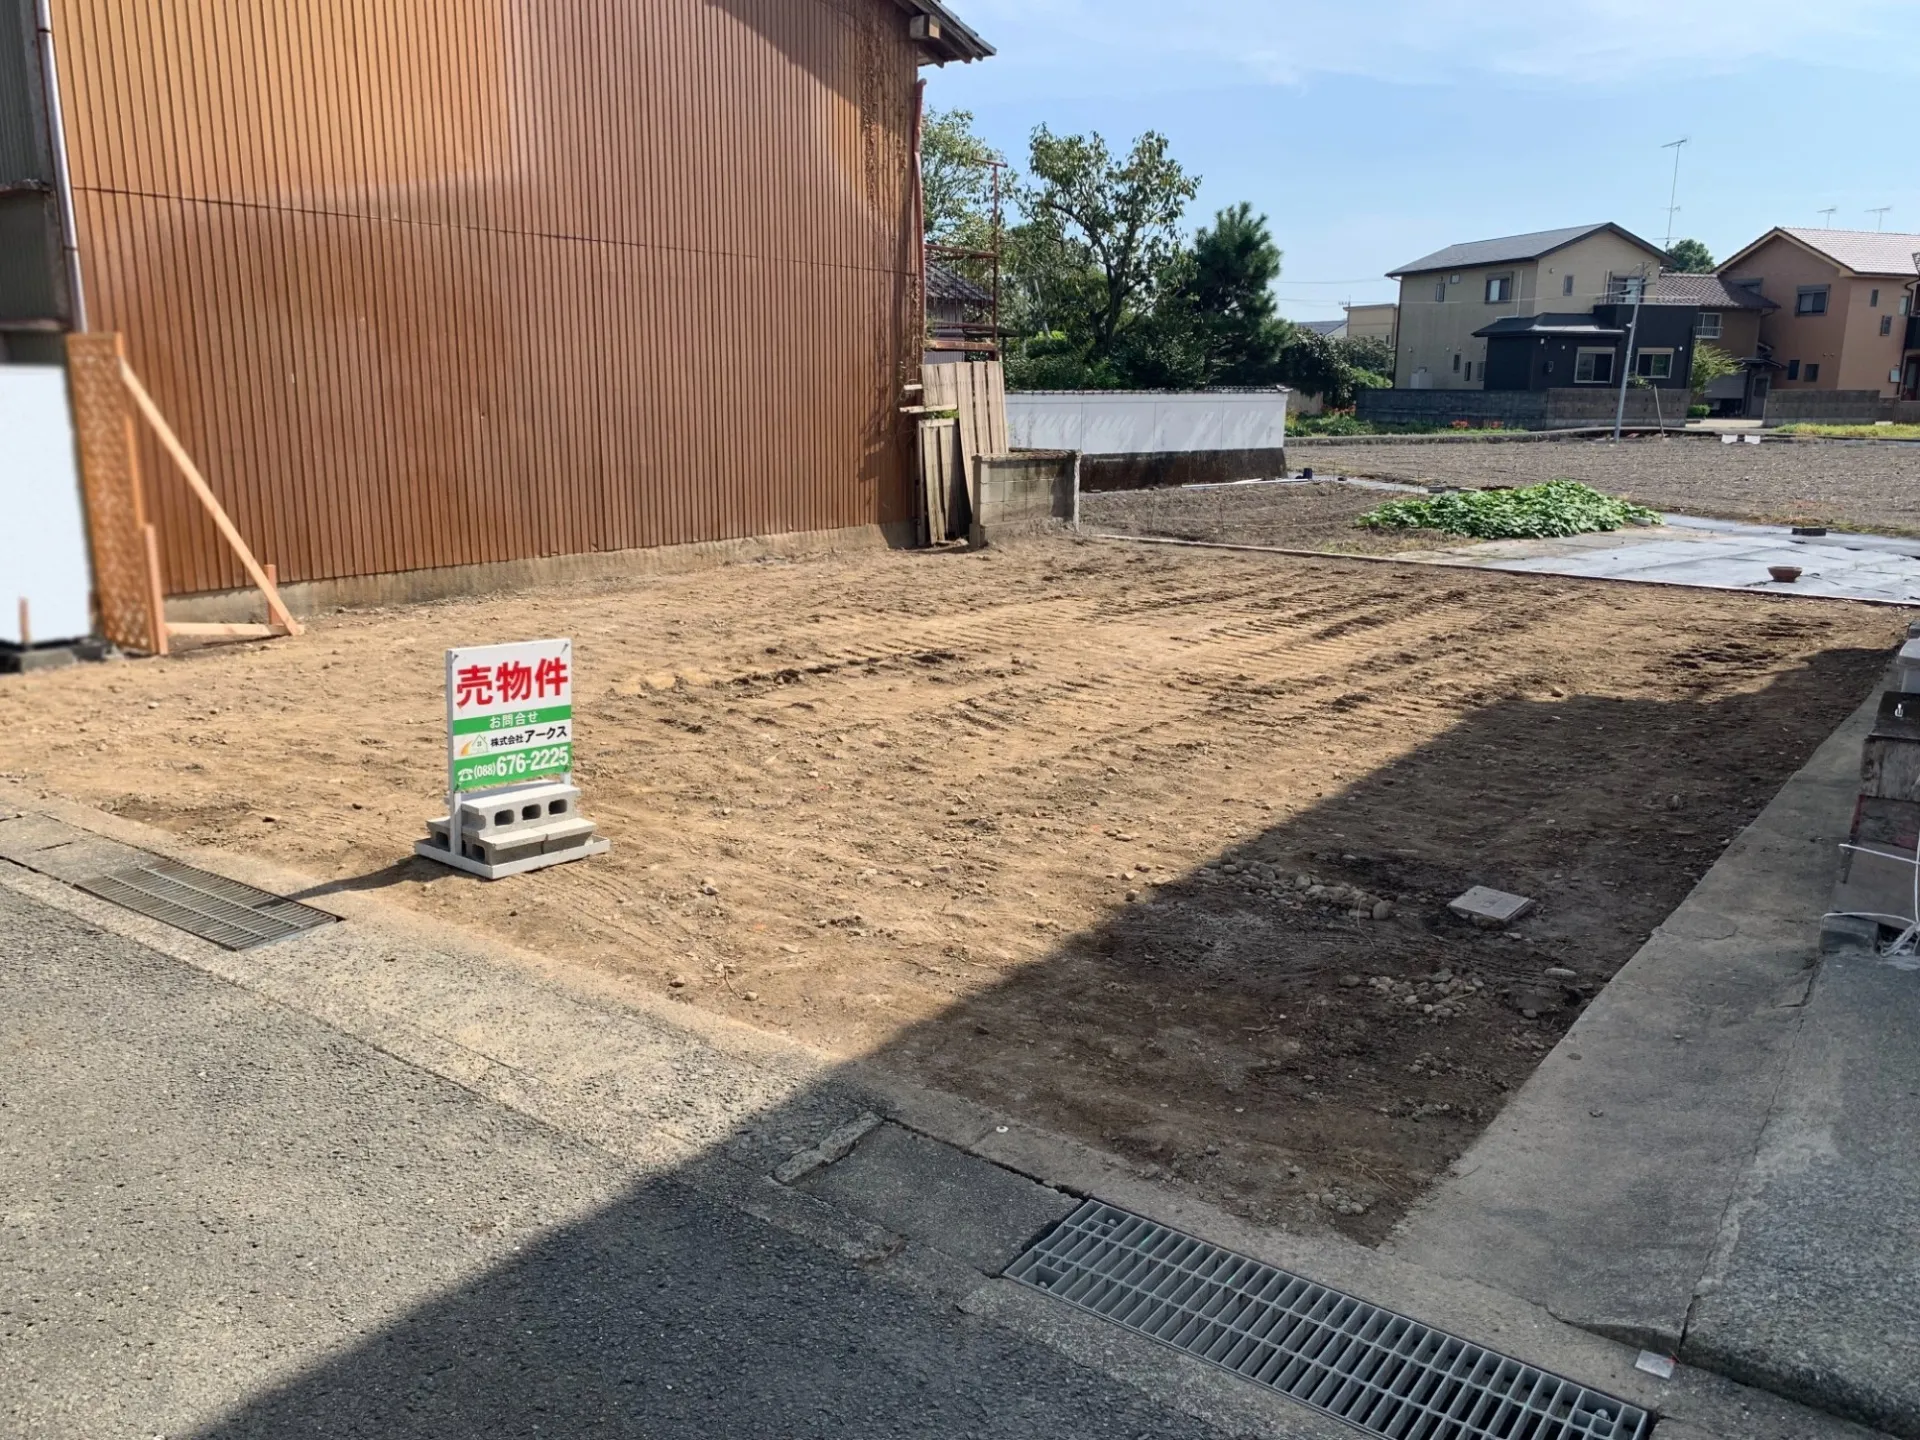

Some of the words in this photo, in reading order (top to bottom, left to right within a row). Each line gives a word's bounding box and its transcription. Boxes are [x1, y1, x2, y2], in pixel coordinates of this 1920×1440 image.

[457, 657, 568, 708] 売物件
[489, 712, 538, 728] お問合せ
[490, 726, 567, 747] 株式会社アークス
[474, 747, 568, 779] (088)676-2225
